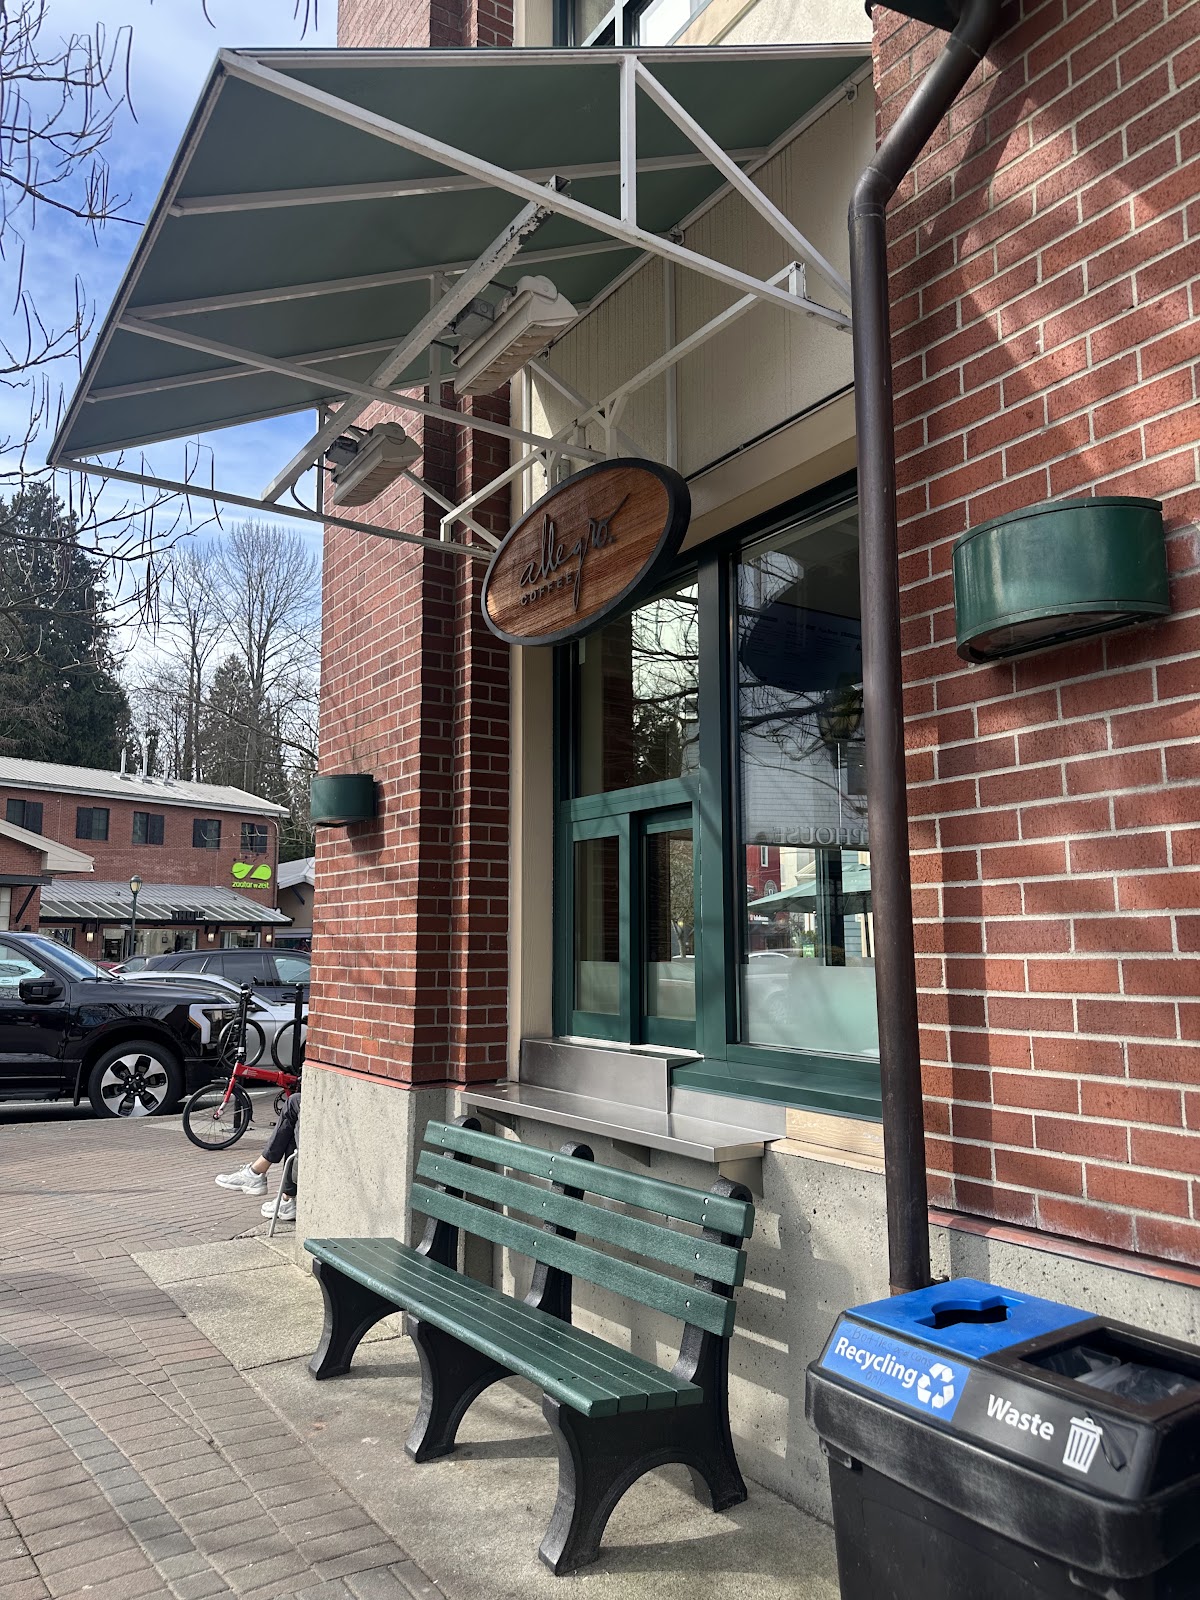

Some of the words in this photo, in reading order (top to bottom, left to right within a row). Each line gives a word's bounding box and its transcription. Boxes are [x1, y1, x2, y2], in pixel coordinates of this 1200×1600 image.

[520, 573, 573, 606] COFFEE
[834, 1336, 918, 1389] Recycling
[986, 1393, 1055, 1441] Waste
